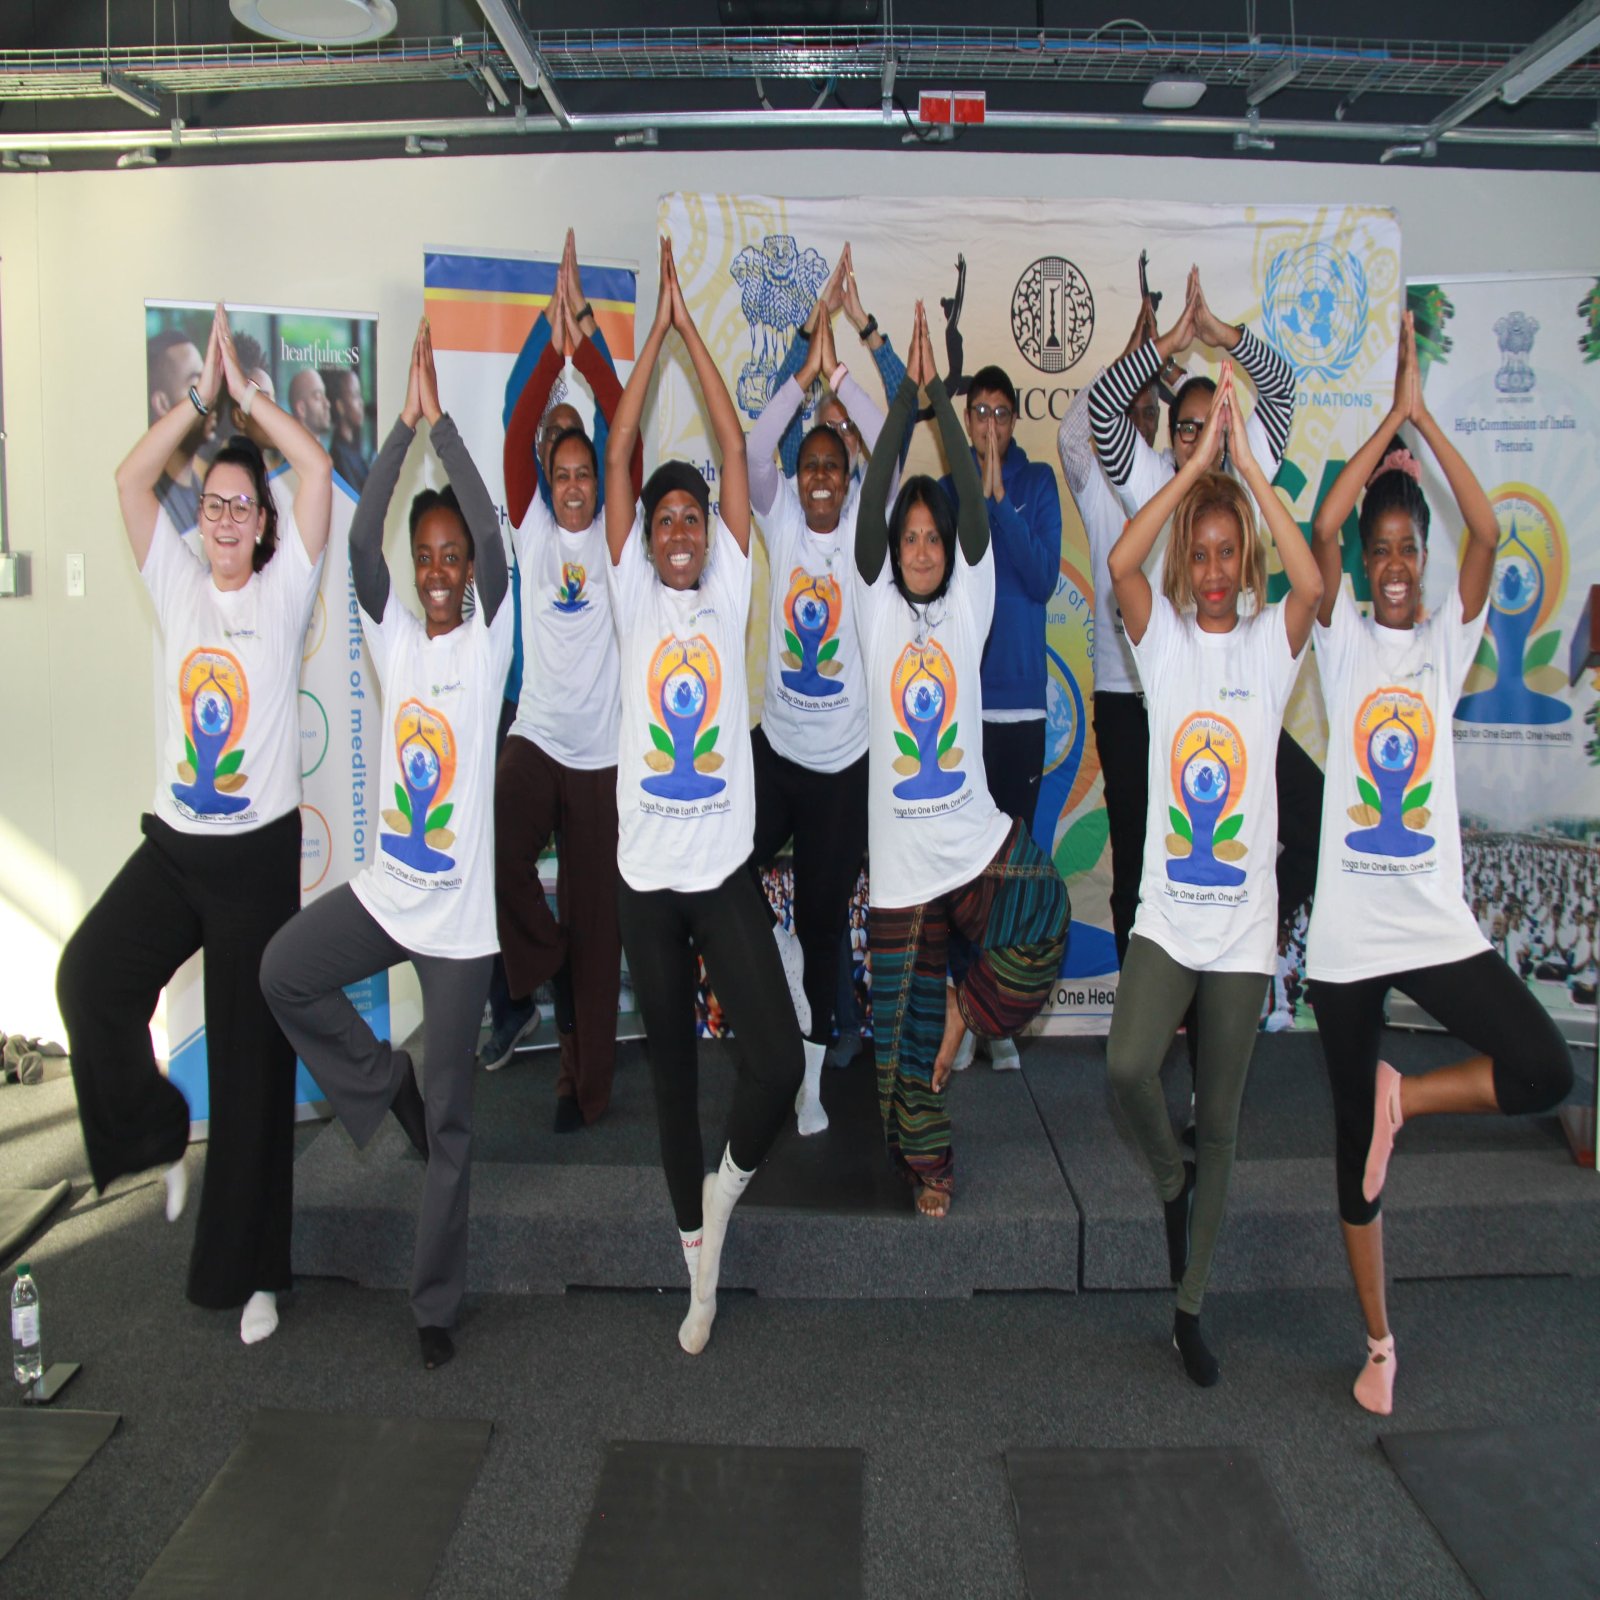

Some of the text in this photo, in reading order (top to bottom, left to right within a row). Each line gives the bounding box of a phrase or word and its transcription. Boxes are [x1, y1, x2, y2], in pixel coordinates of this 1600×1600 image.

[280, 336, 360, 369] heartfulness
[1014, 387, 1080, 420] ICC
[1311, 392, 1372, 407] NATIONS
[1454, 417, 1477, 435] High
[1479, 416, 1537, 431] Commission
[1550, 414, 1576, 430] India
[1068, 590, 1086, 611] of
[1047, 612, 1067, 624] une
[350, 671, 365, 699] of
[350, 709, 368, 862] meditation
[1179, 890, 1195, 900] One
[1218, 892, 1233, 902] One
[1057, 988, 1085, 1005] One
[1087, 988, 1115, 1005] Hea
